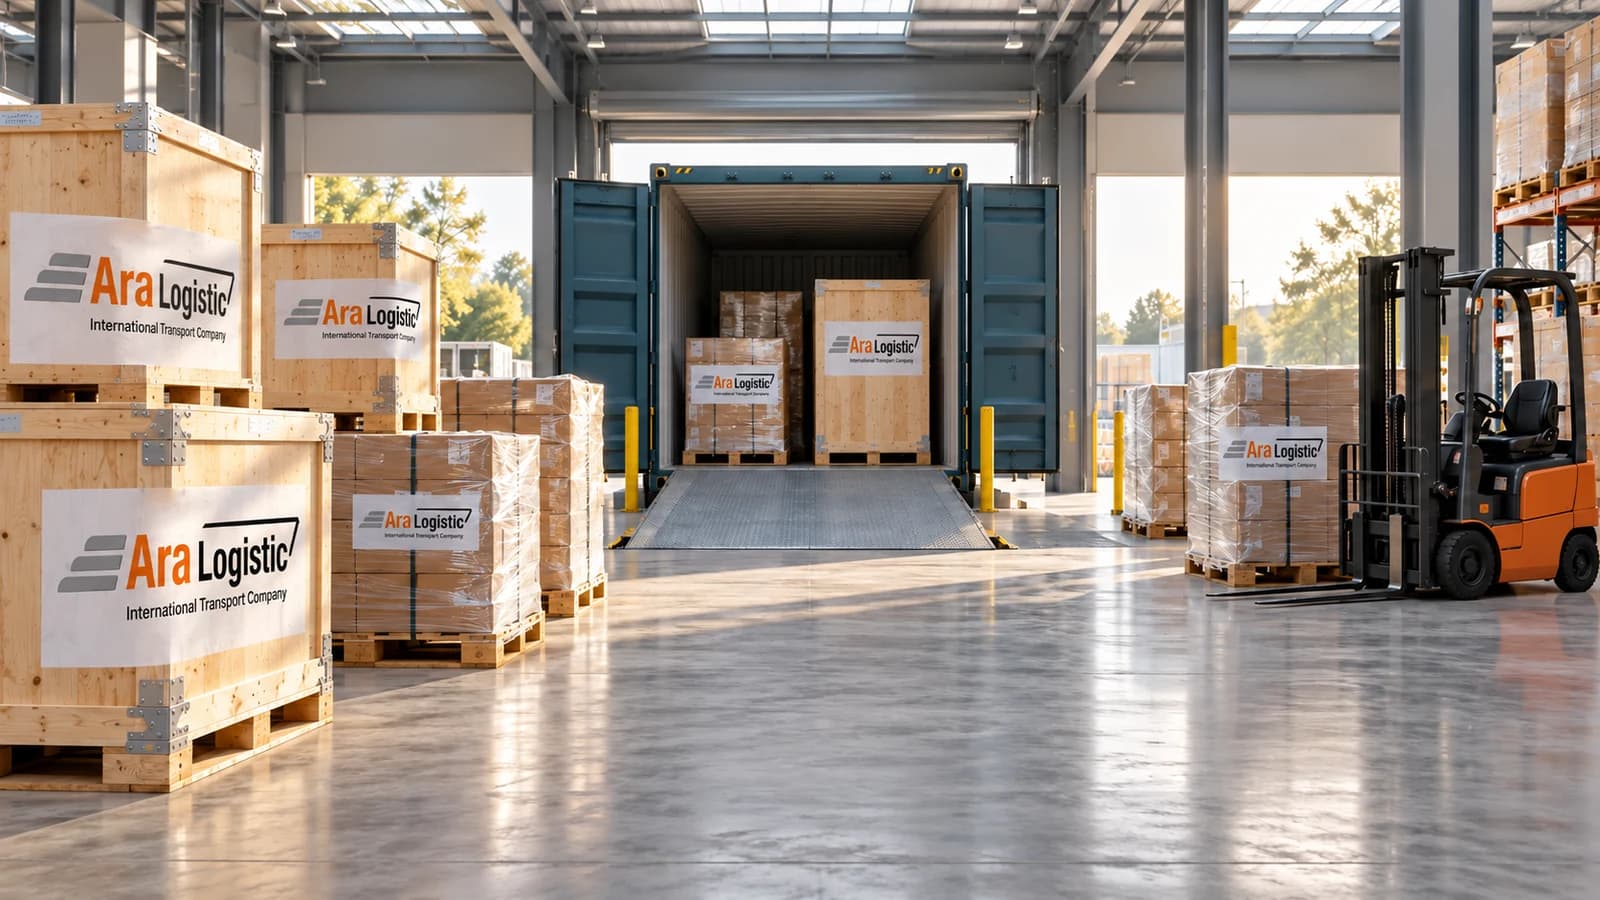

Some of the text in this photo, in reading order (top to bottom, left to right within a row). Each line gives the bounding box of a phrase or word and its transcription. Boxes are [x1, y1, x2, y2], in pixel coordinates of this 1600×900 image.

[90, 256, 227, 320] Ara Logistic
[322, 299, 416, 329] Ara Logistic
[90, 318, 226, 343] International Transport Company
[368, 332, 398, 340] Transport
[849, 336, 914, 356] Ara Logistic
[713, 375, 770, 391] Ara Logistic
[1247, 440, 1317, 461] Ara Logistic
[385, 511, 464, 532] Ara Logistic
[126, 533, 288, 590] Ara Logistic
[126, 589, 287, 621] International Transport Company
